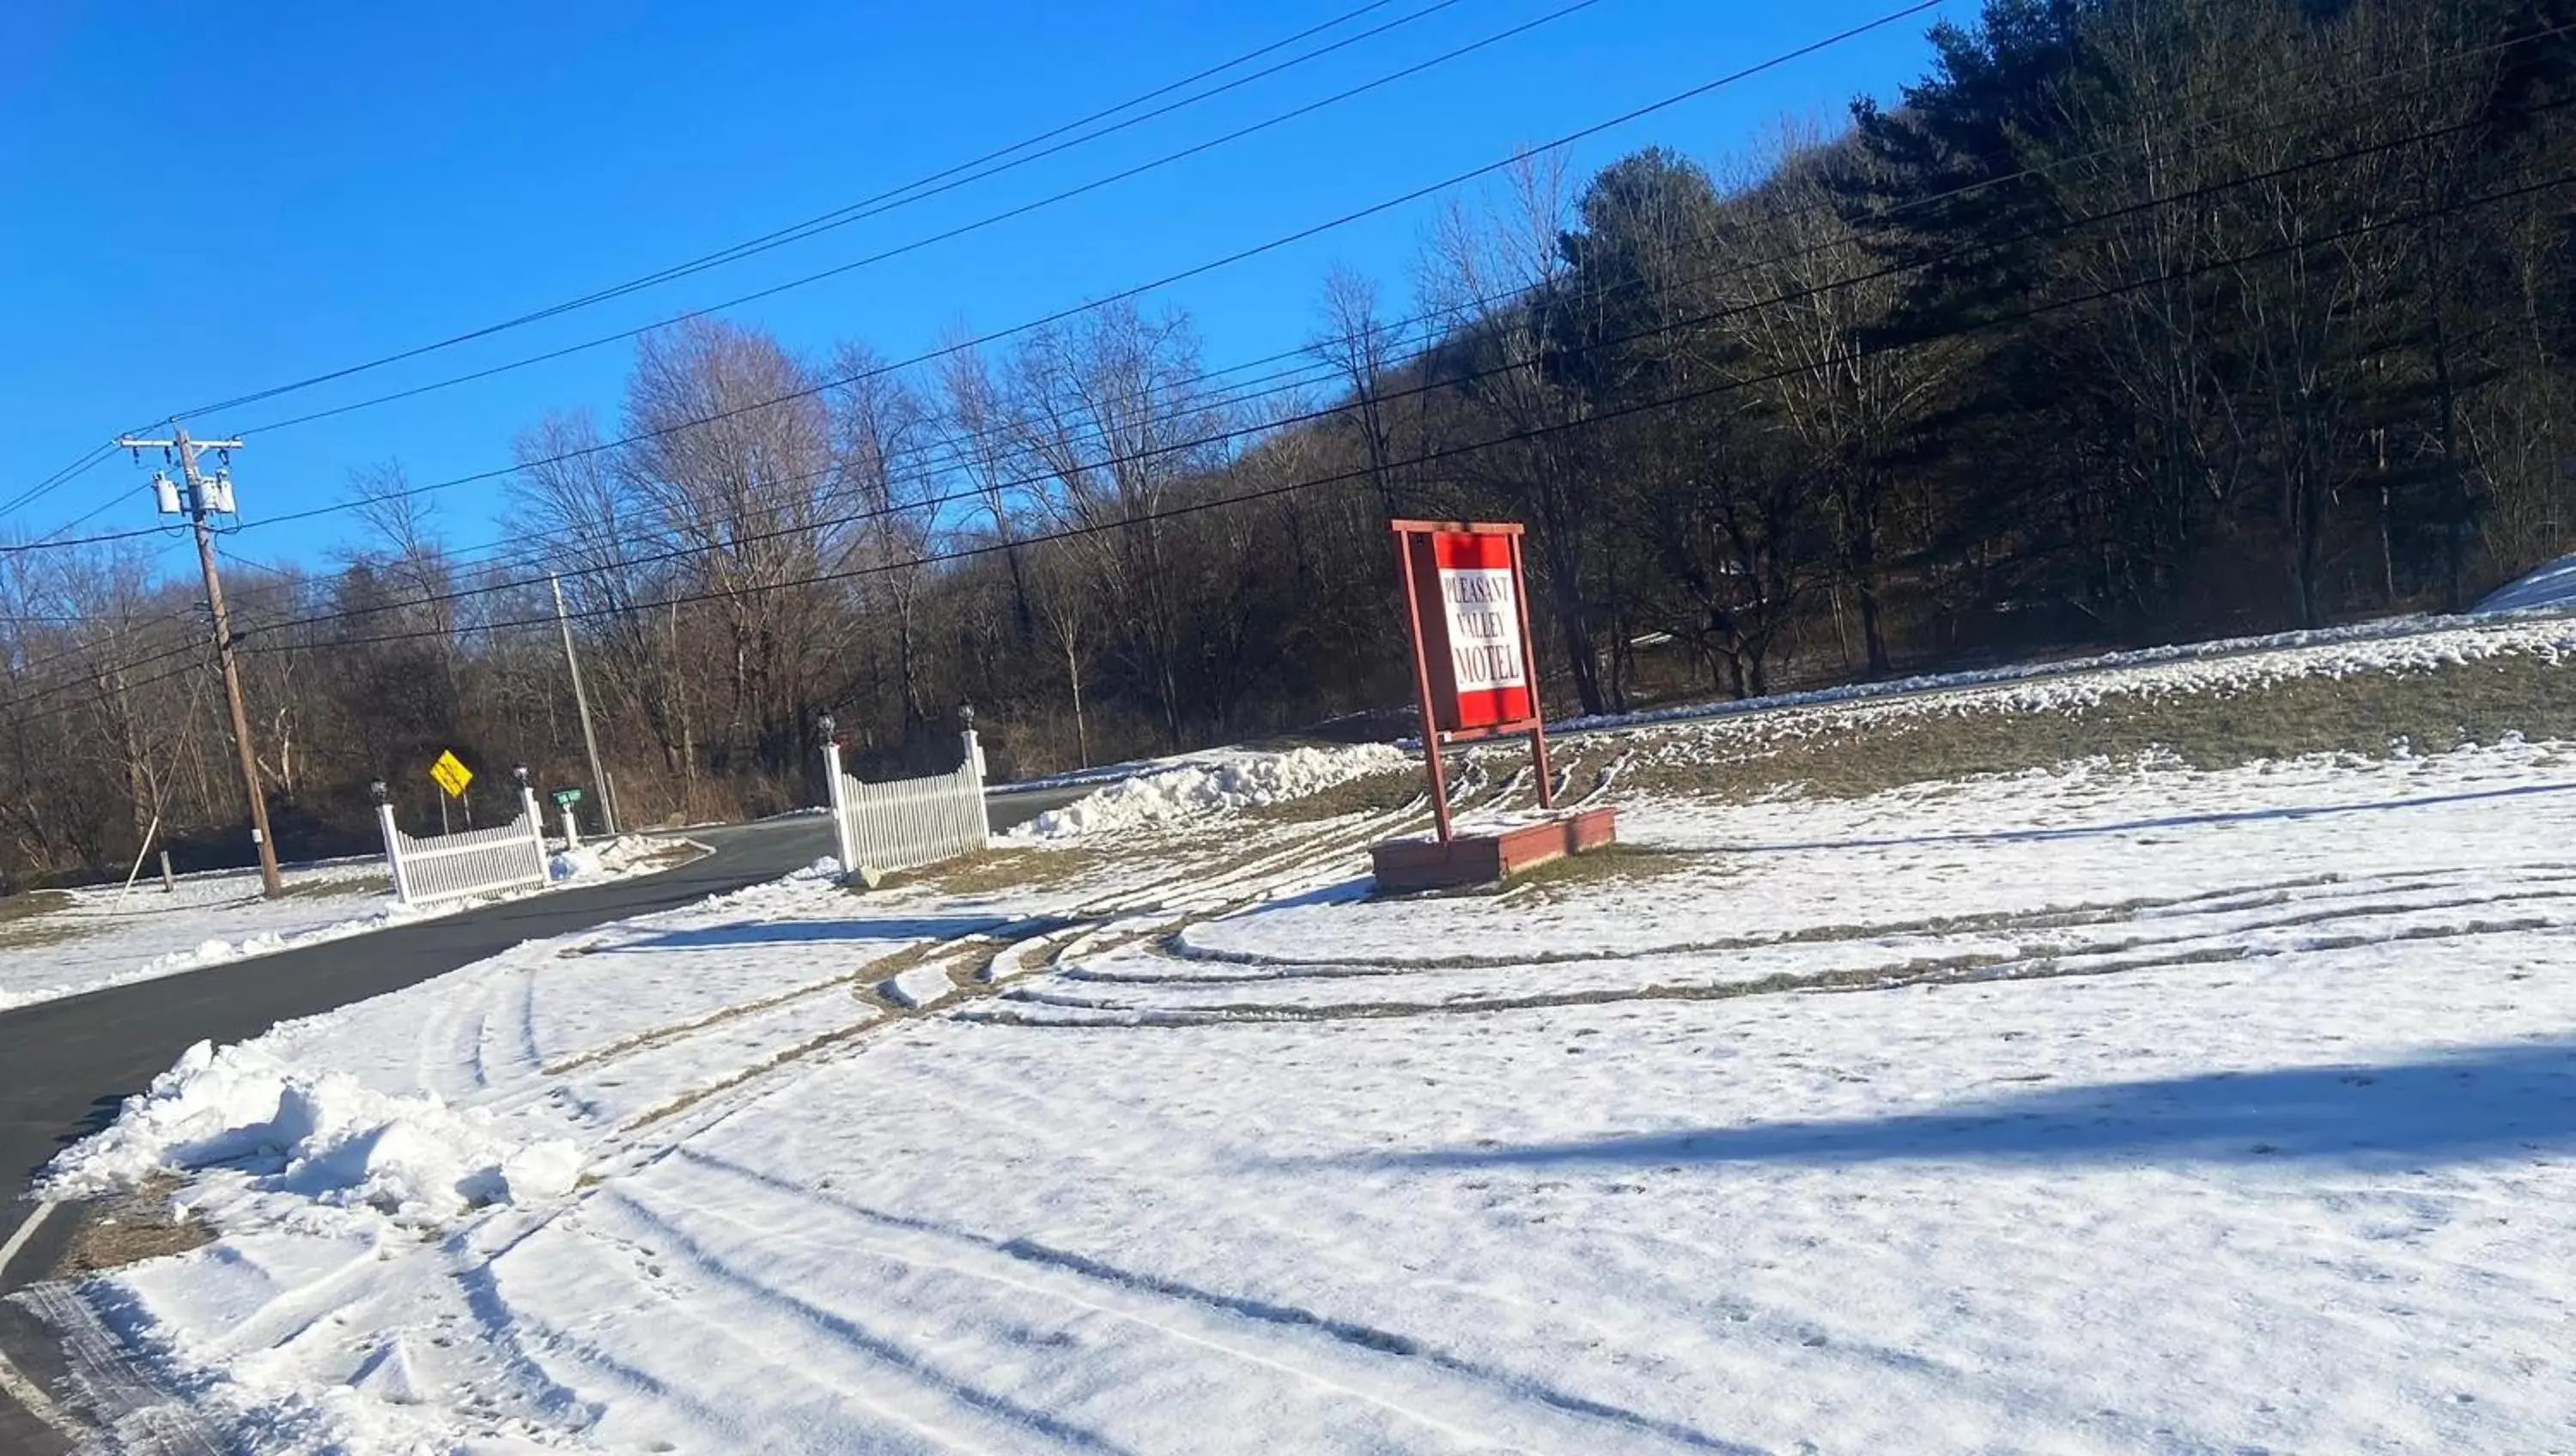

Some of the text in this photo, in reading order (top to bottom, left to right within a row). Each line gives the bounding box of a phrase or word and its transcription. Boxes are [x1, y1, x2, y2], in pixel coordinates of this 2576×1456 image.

[1444, 577, 1509, 603] PLEASANT
[1456, 611, 1505, 638] VALLEY
[1455, 644, 1519, 683] MOTEL
